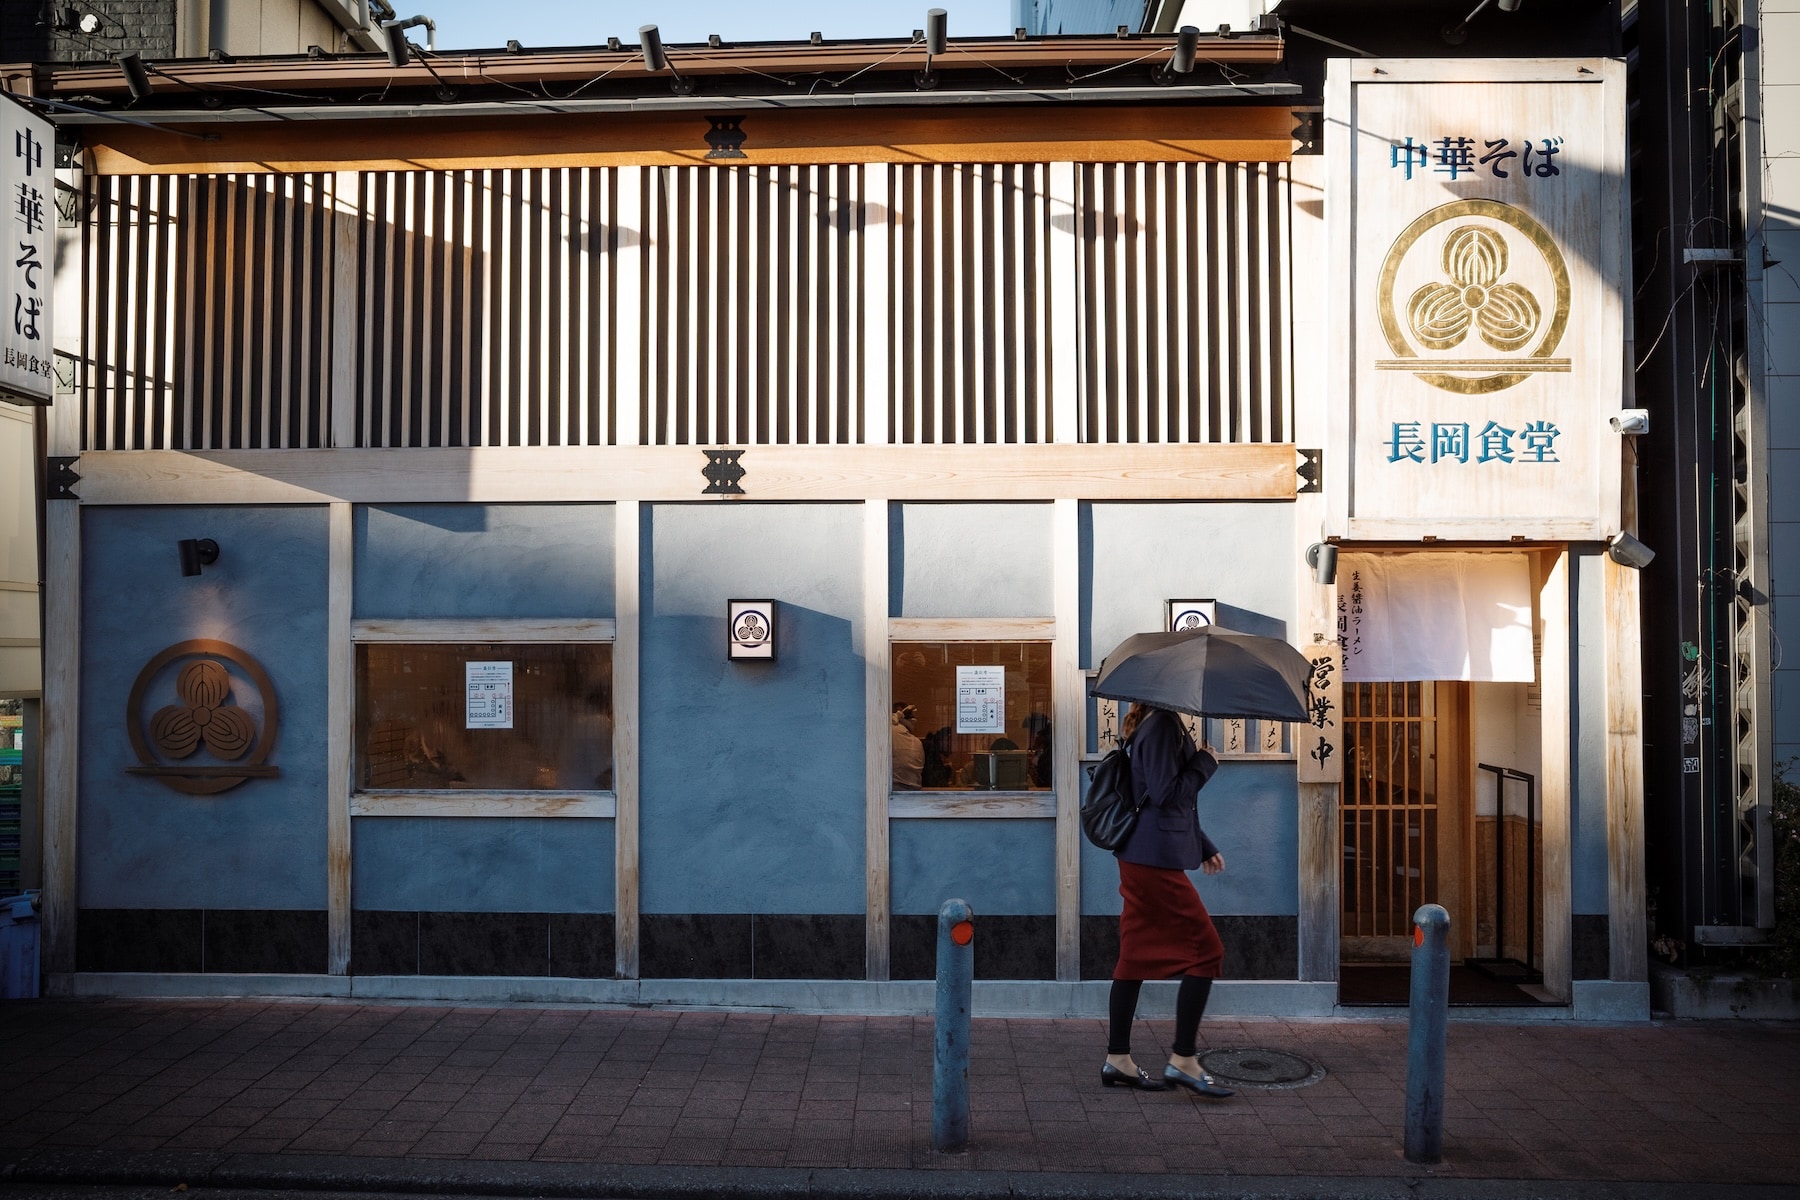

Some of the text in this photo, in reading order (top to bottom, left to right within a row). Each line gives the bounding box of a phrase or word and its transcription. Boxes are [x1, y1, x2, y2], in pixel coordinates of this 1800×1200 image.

[1390, 136, 1564, 181] 中華そば
[15, 127, 44, 341] 中華そば
[3, 347, 51, 379] 長岡食堂
[1383, 420, 1561, 465] 長岡食堂
[1311, 656, 1335, 771] 営業中
